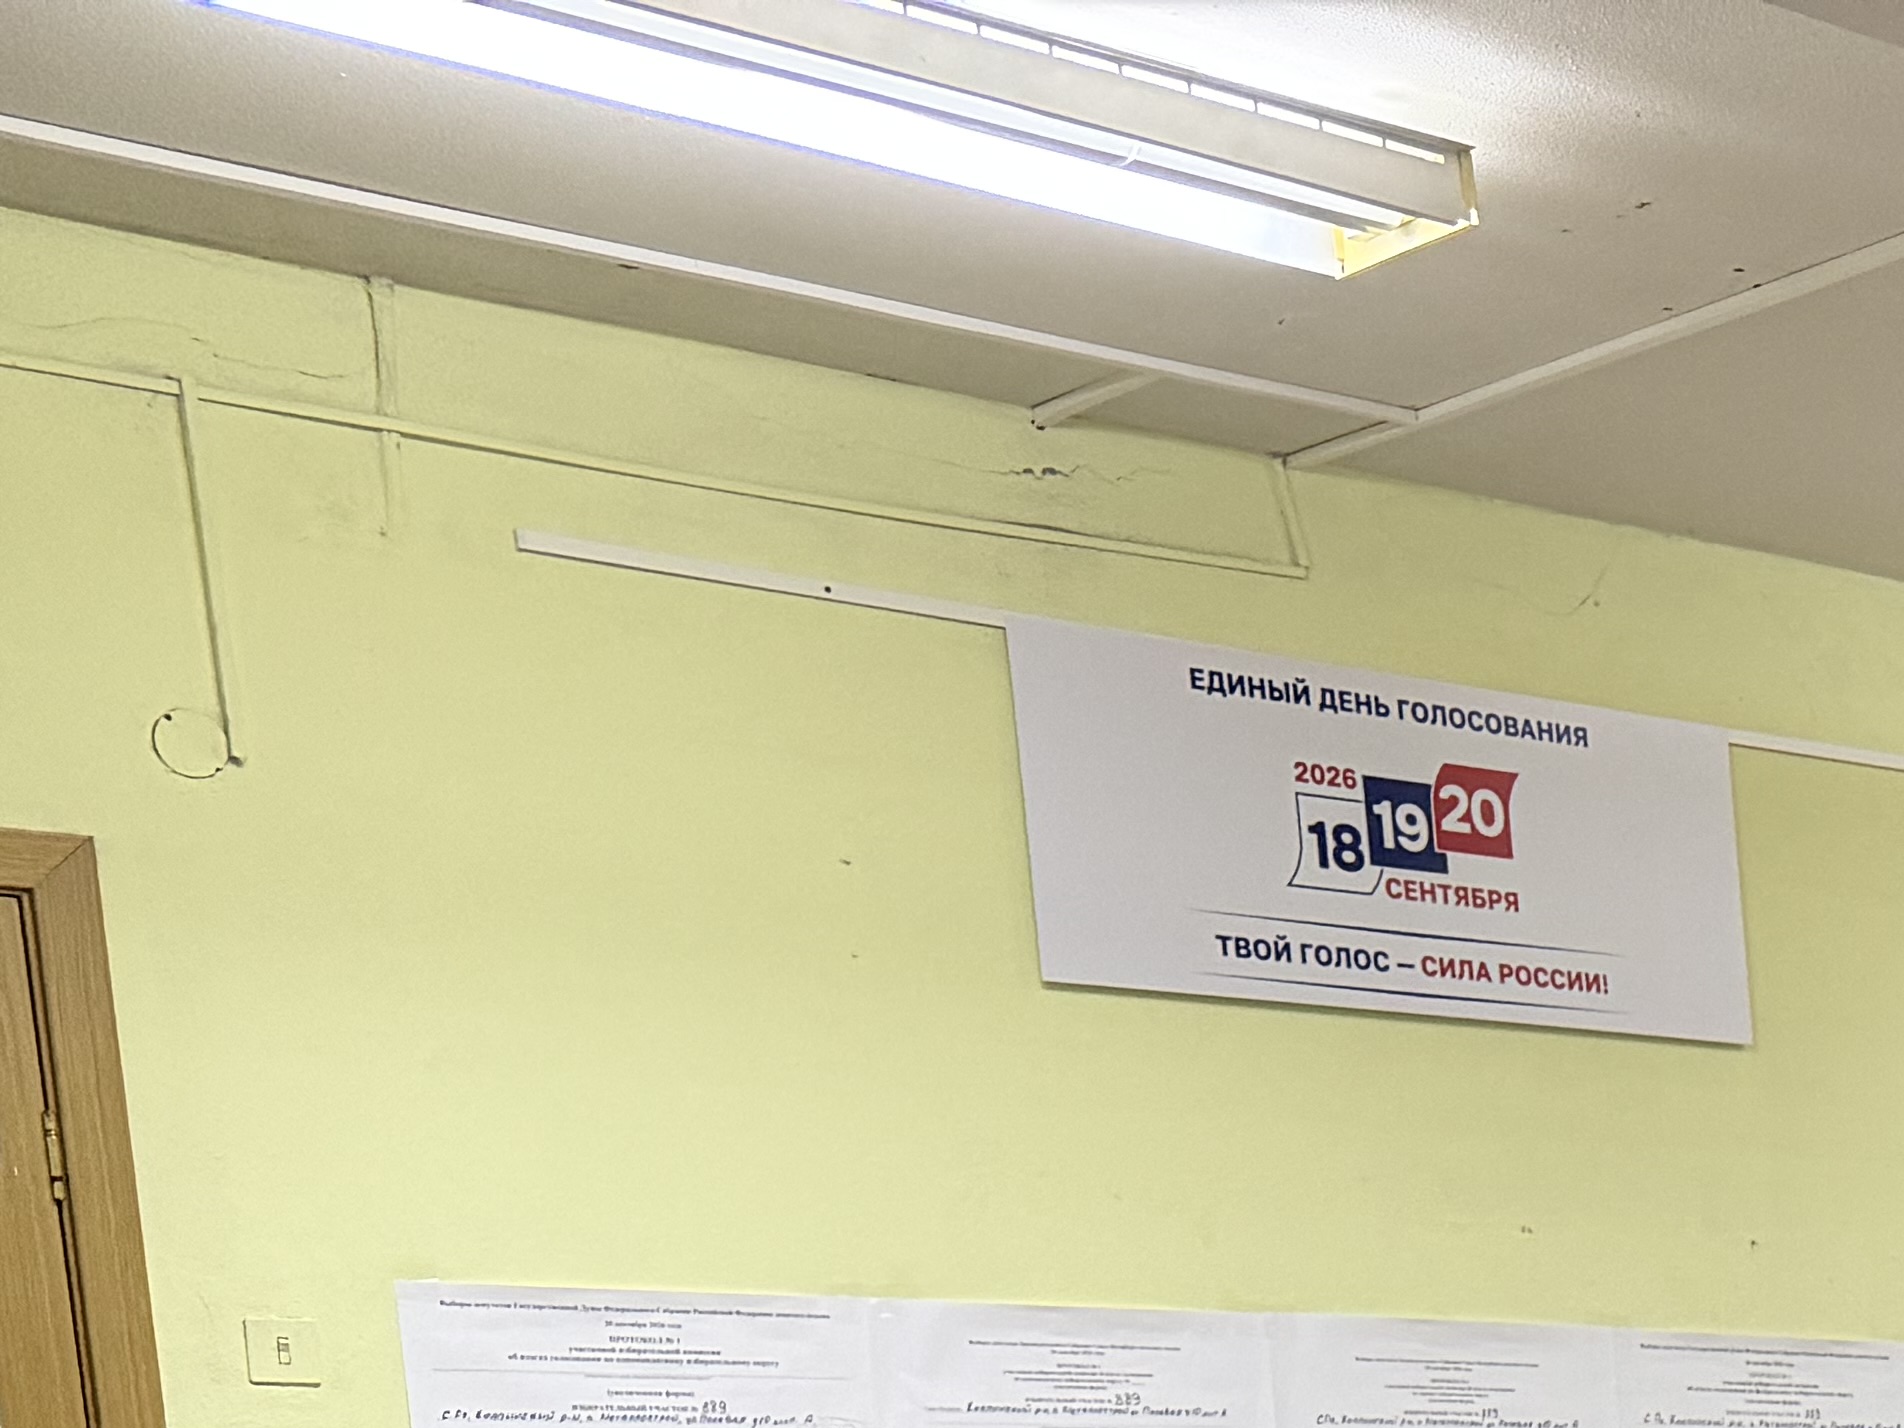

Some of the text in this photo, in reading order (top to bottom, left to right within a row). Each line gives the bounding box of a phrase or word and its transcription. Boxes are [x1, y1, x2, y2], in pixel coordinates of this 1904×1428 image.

[1189, 667, 1590, 748] ЕДИНЫЙ ДЕНЬ ГОЛОСОВАНИЯ
[1294, 761, 1357, 790] 2026
[1308, 784, 1506, 873] 18 19 20
[1385, 877, 1520, 914] СЕНТЯБРЯ
[1216, 934, 1293, 967] ТВОЙ
[1300, 941, 1390, 974] ГОЛОС
[1421, 956, 1493, 985] СИЛА
[1500, 964, 1610, 995] РОССИИ!
